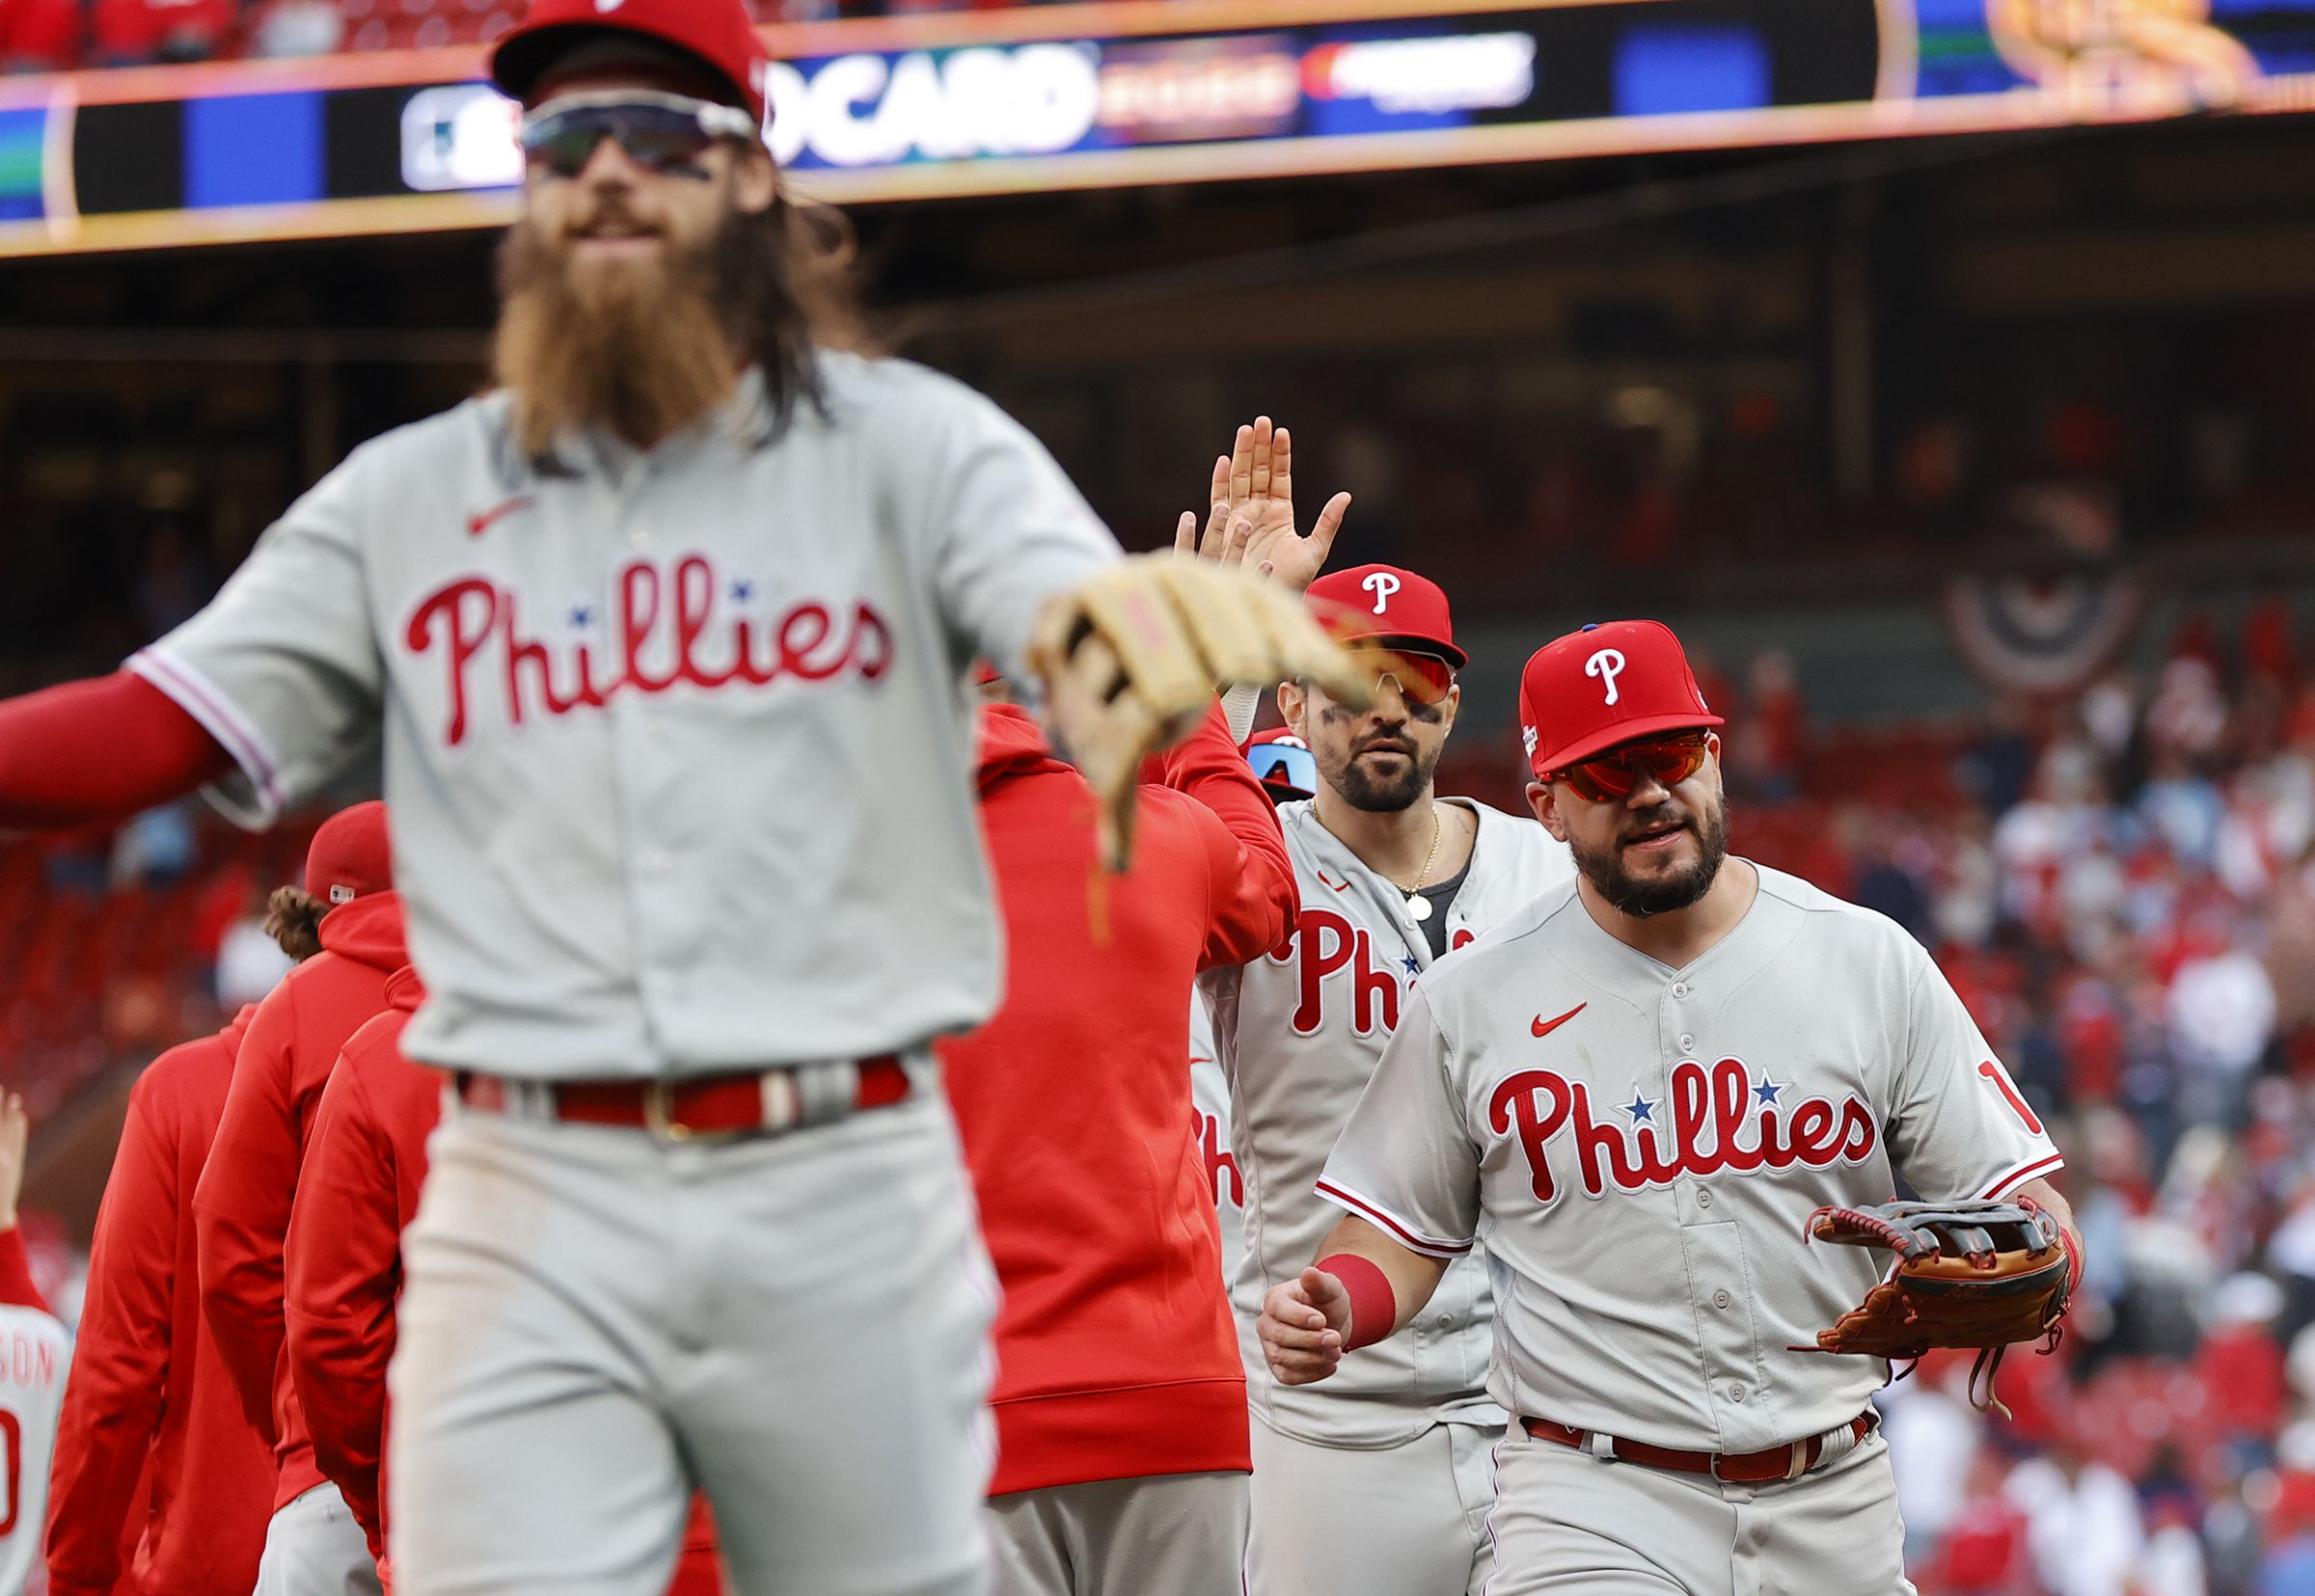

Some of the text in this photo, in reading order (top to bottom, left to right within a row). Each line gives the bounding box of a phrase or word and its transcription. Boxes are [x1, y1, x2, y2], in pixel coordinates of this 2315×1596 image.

[1361, 571, 1402, 615] P
[404, 552, 892, 748] Phillies
[1584, 647, 1626, 706] P
[1488, 1056, 1879, 1204] Phillies
[1977, 1061, 2044, 1136] 1
